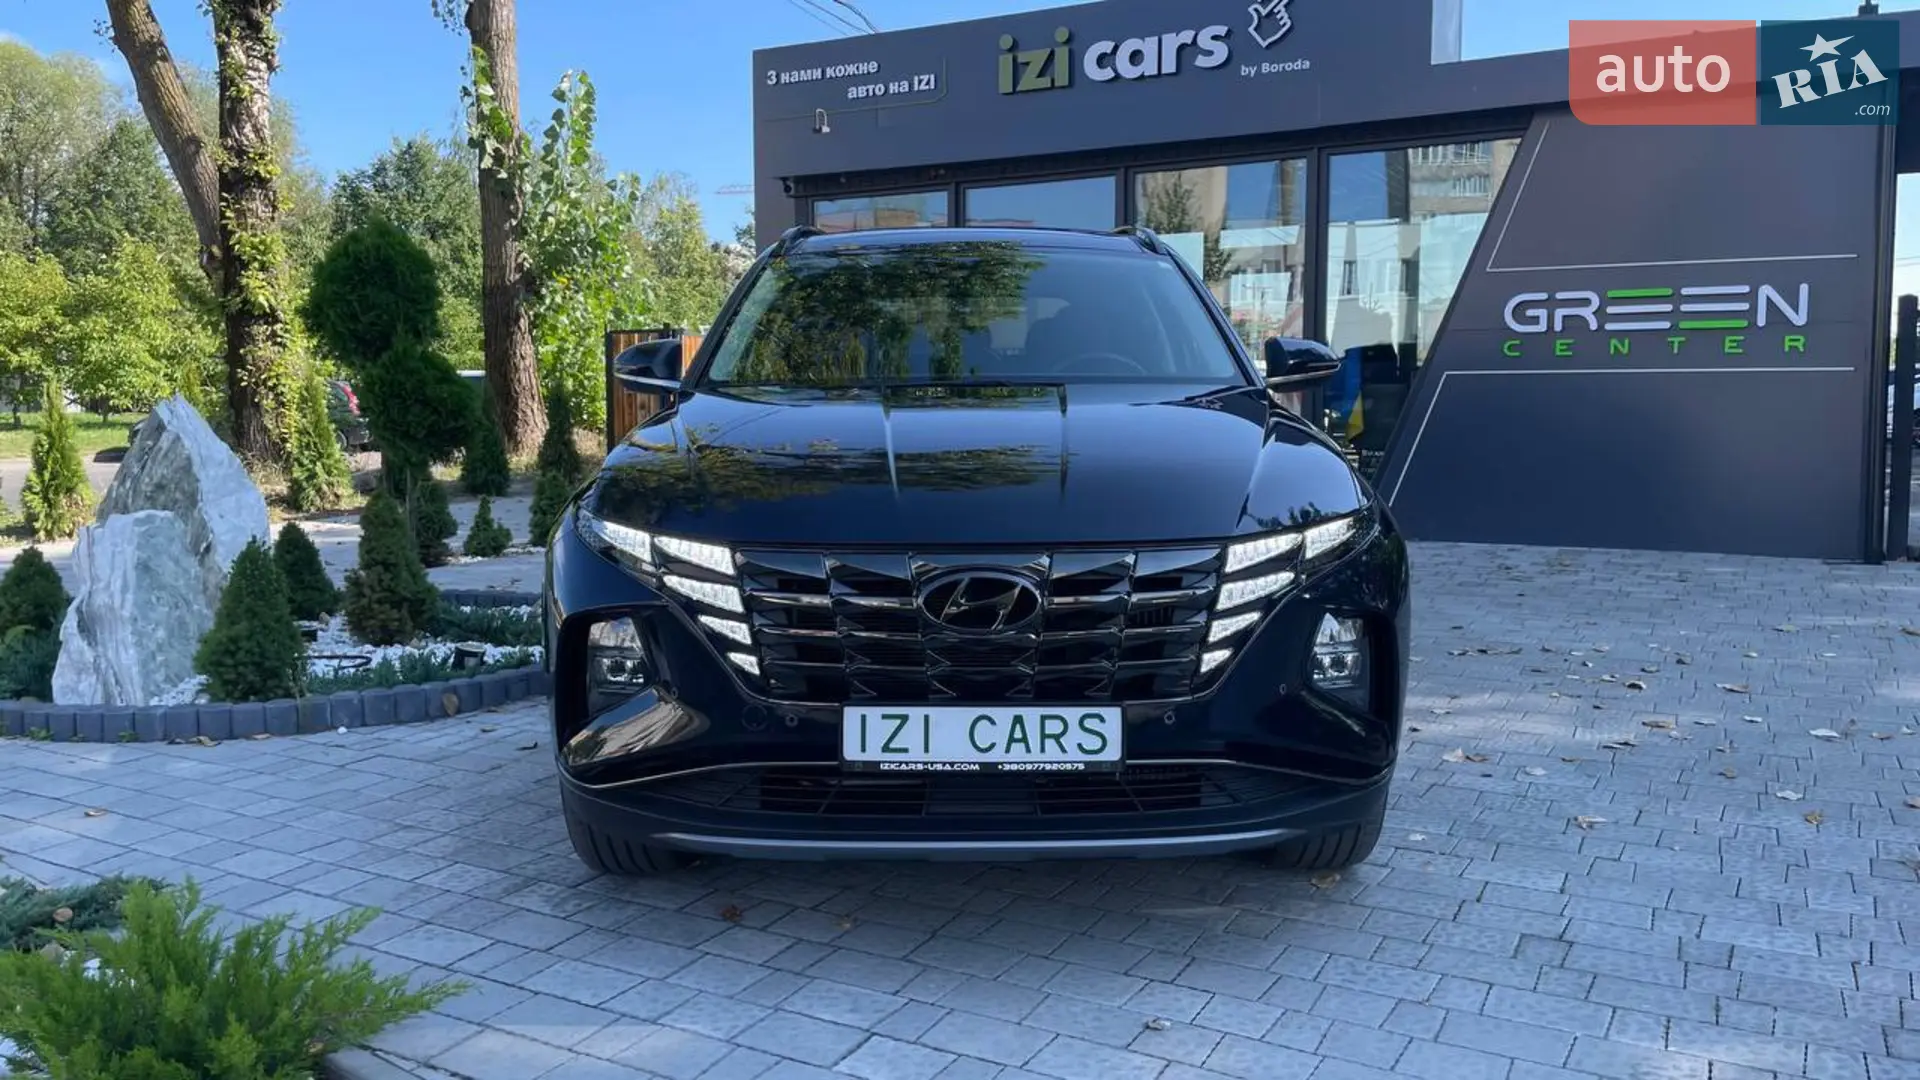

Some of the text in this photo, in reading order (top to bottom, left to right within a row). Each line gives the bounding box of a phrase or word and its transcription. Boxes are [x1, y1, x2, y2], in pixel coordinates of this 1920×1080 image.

[998, 24, 1230, 94] izi cars
[1240, 58, 1311, 77] by Boroda
[780, 67, 822, 84] нами
[826, 61, 879, 79] кожне
[847, 74, 936, 99] авто на IZI
[1503, 283, 1810, 333] GREEN
[1502, 335, 1806, 357] CENTER
[860, 713, 1108, 755] IZI CARS
[880, 762, 980, 771] IZICARS-USA.COM
